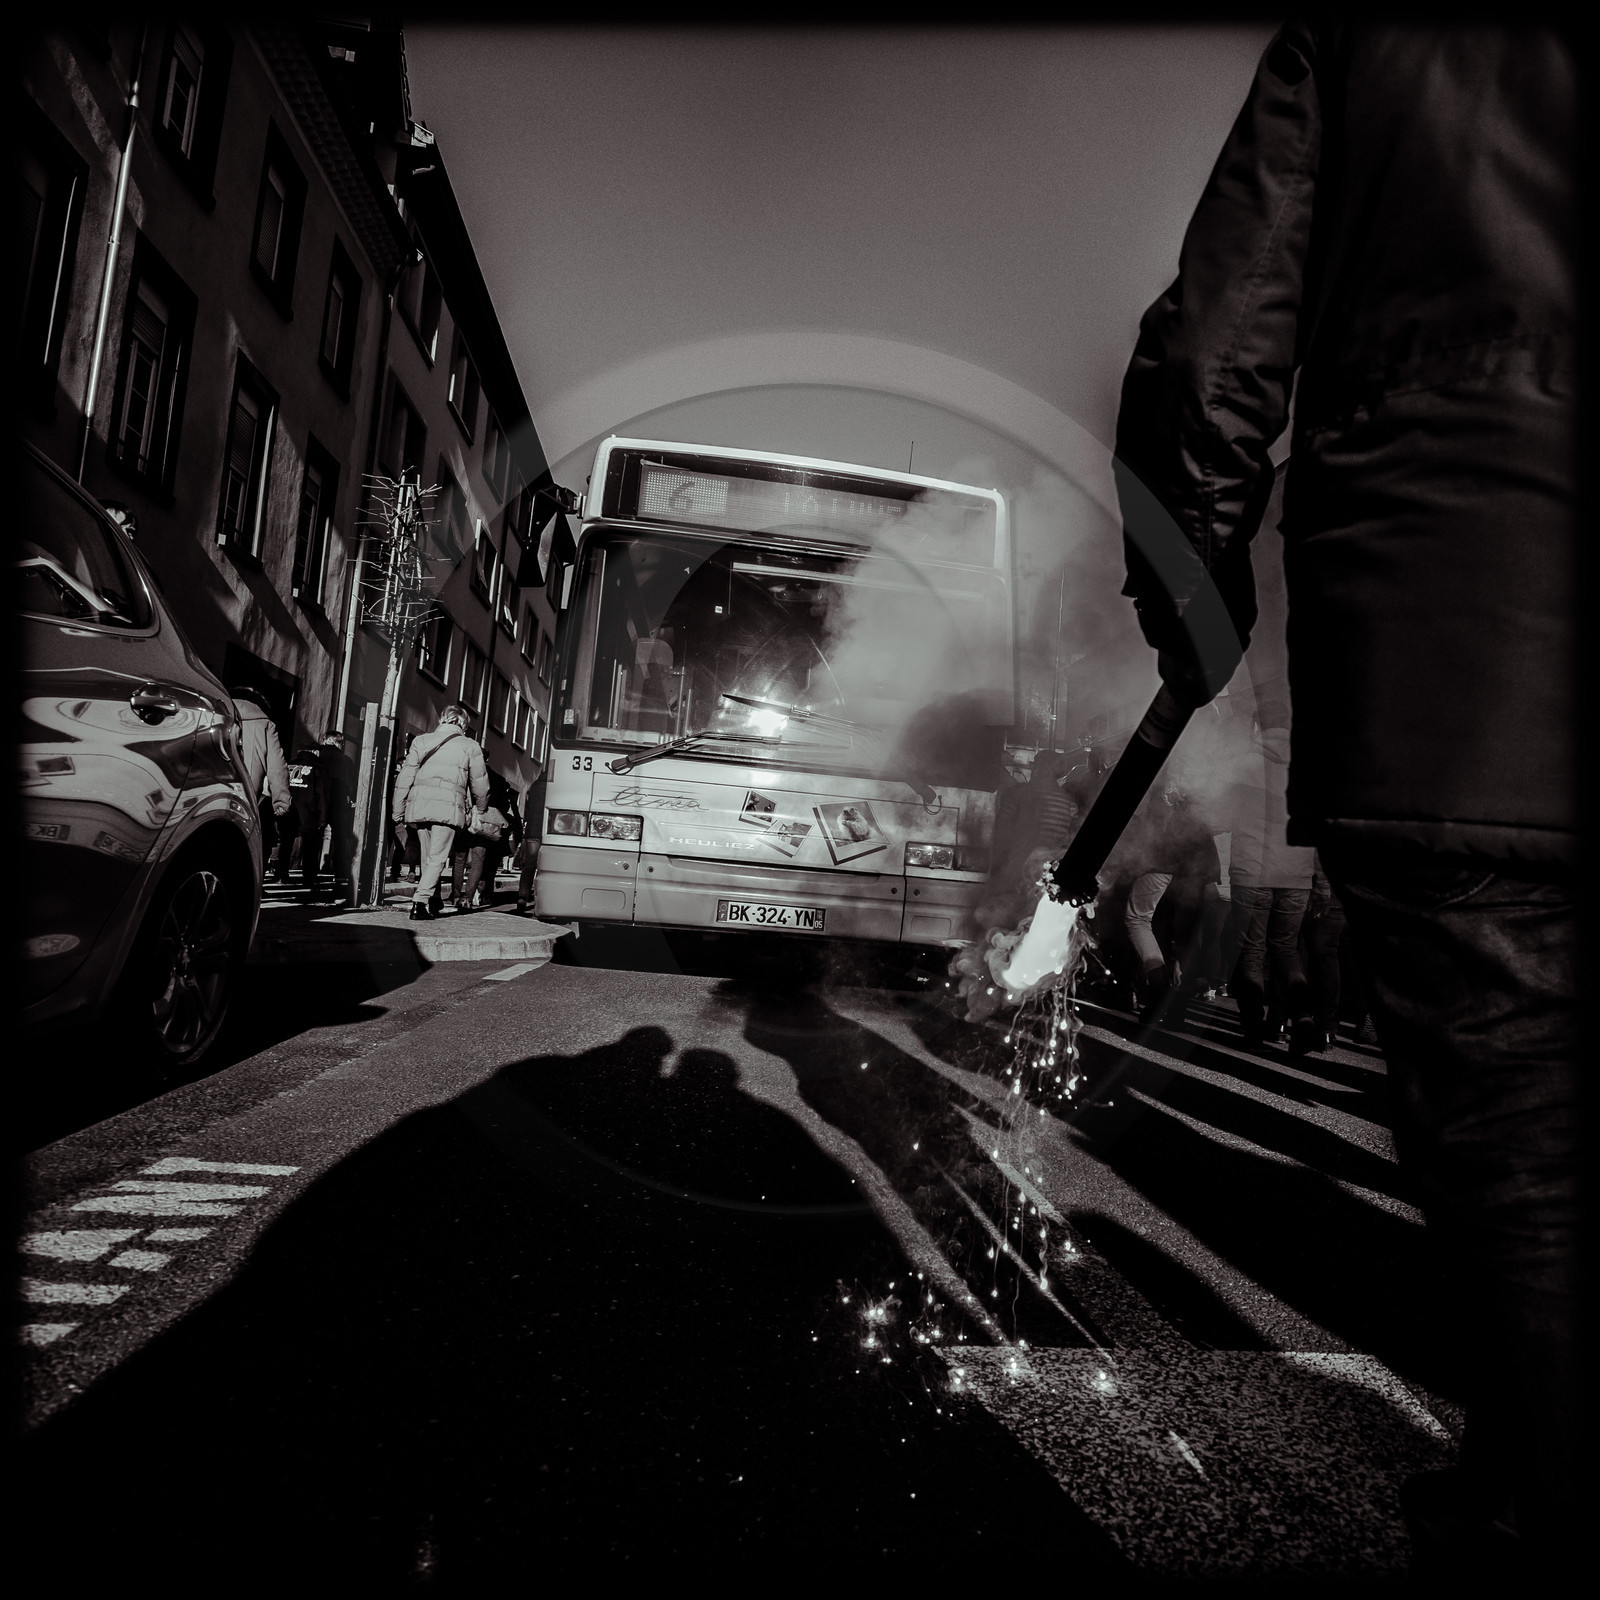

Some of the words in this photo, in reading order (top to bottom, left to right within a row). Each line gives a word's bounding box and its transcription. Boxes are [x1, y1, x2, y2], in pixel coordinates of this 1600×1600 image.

[667, 480, 697, 512] 6
[572, 755, 593, 771] 33
[669, 836, 757, 850] HEULIEZ
[814, 920, 823, 929] 05
